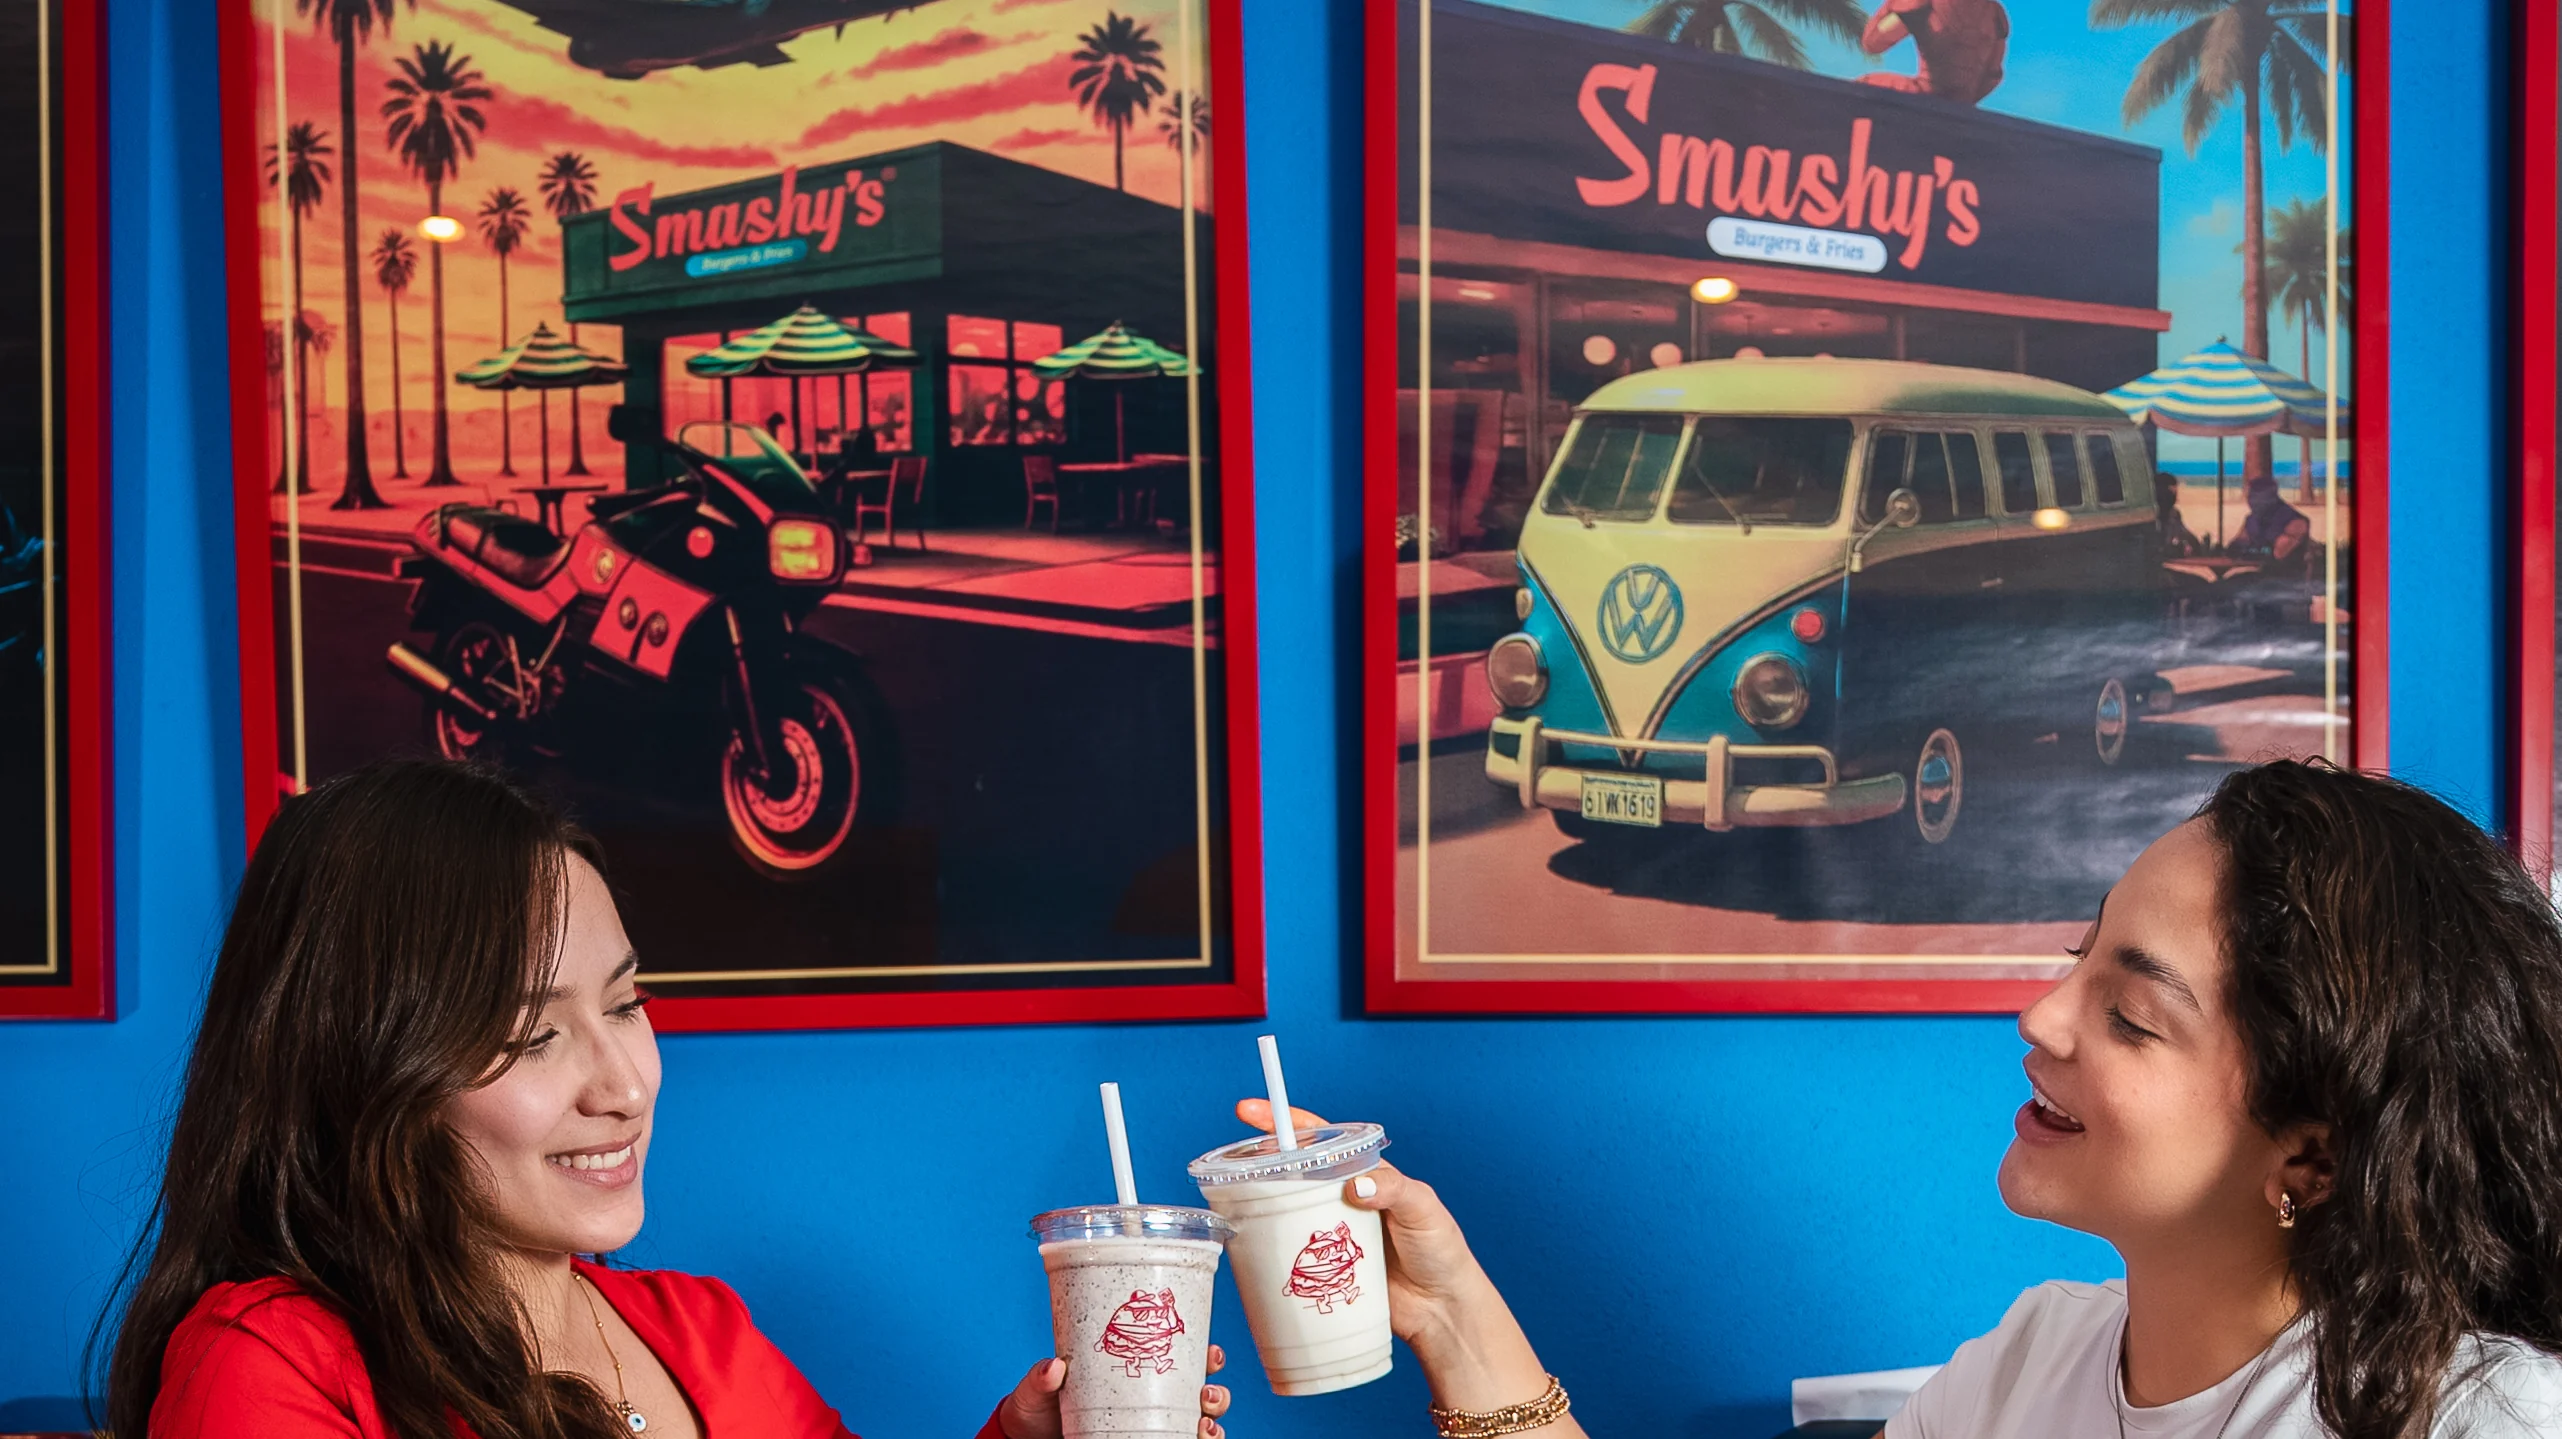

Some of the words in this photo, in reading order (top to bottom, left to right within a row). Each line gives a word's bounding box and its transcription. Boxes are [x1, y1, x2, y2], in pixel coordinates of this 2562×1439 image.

[609, 165, 885, 272] Smashy's
[1576, 63, 1980, 269] Smashy's
[1733, 226, 1801, 256] Burgers
[1805, 235, 1821, 254] &
[1825, 238, 1864, 260] Fries
